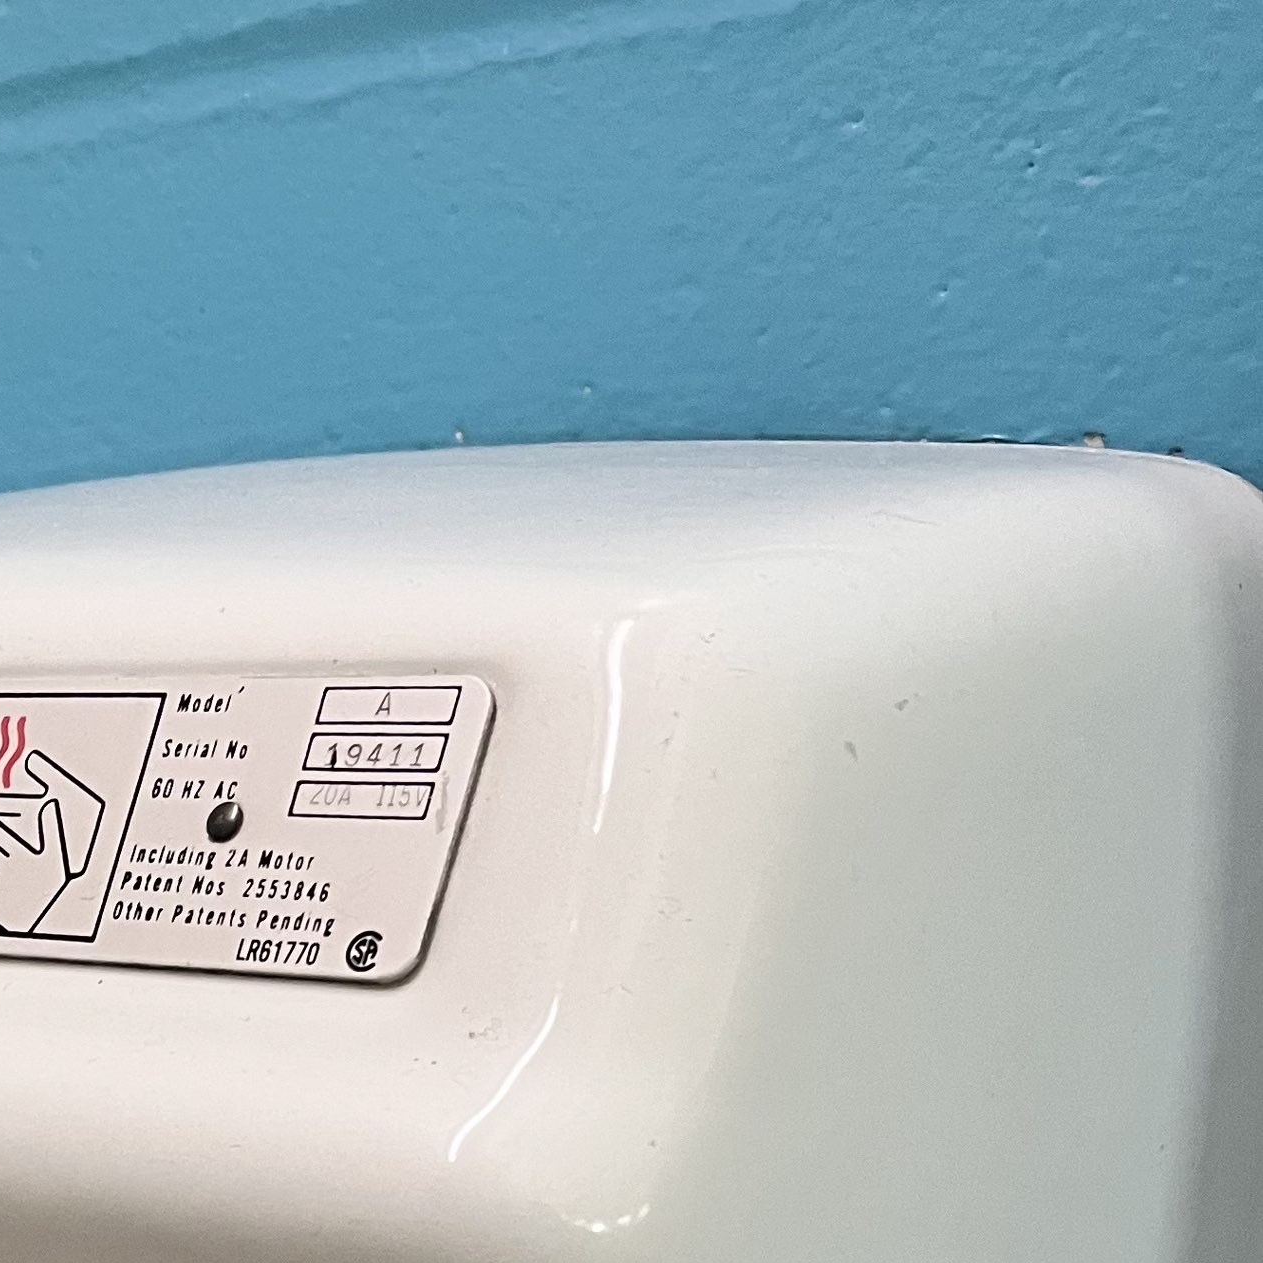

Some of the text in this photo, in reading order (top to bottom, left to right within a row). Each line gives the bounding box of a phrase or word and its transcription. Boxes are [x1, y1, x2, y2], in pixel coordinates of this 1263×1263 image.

[177, 692, 391, 716] Model A
[162, 739, 424, 768] Serial No 19411
[152, 778, 174, 799] 60
[182, 780, 205, 799] HZ
[213, 781, 238, 800] AC
[130, 844, 315, 871] Including 2A Motor
[120, 871, 330, 902] Patent Nos 2553846
[112, 901, 335, 937] Other Patents Pending
[236, 939, 320, 965] LR61770
